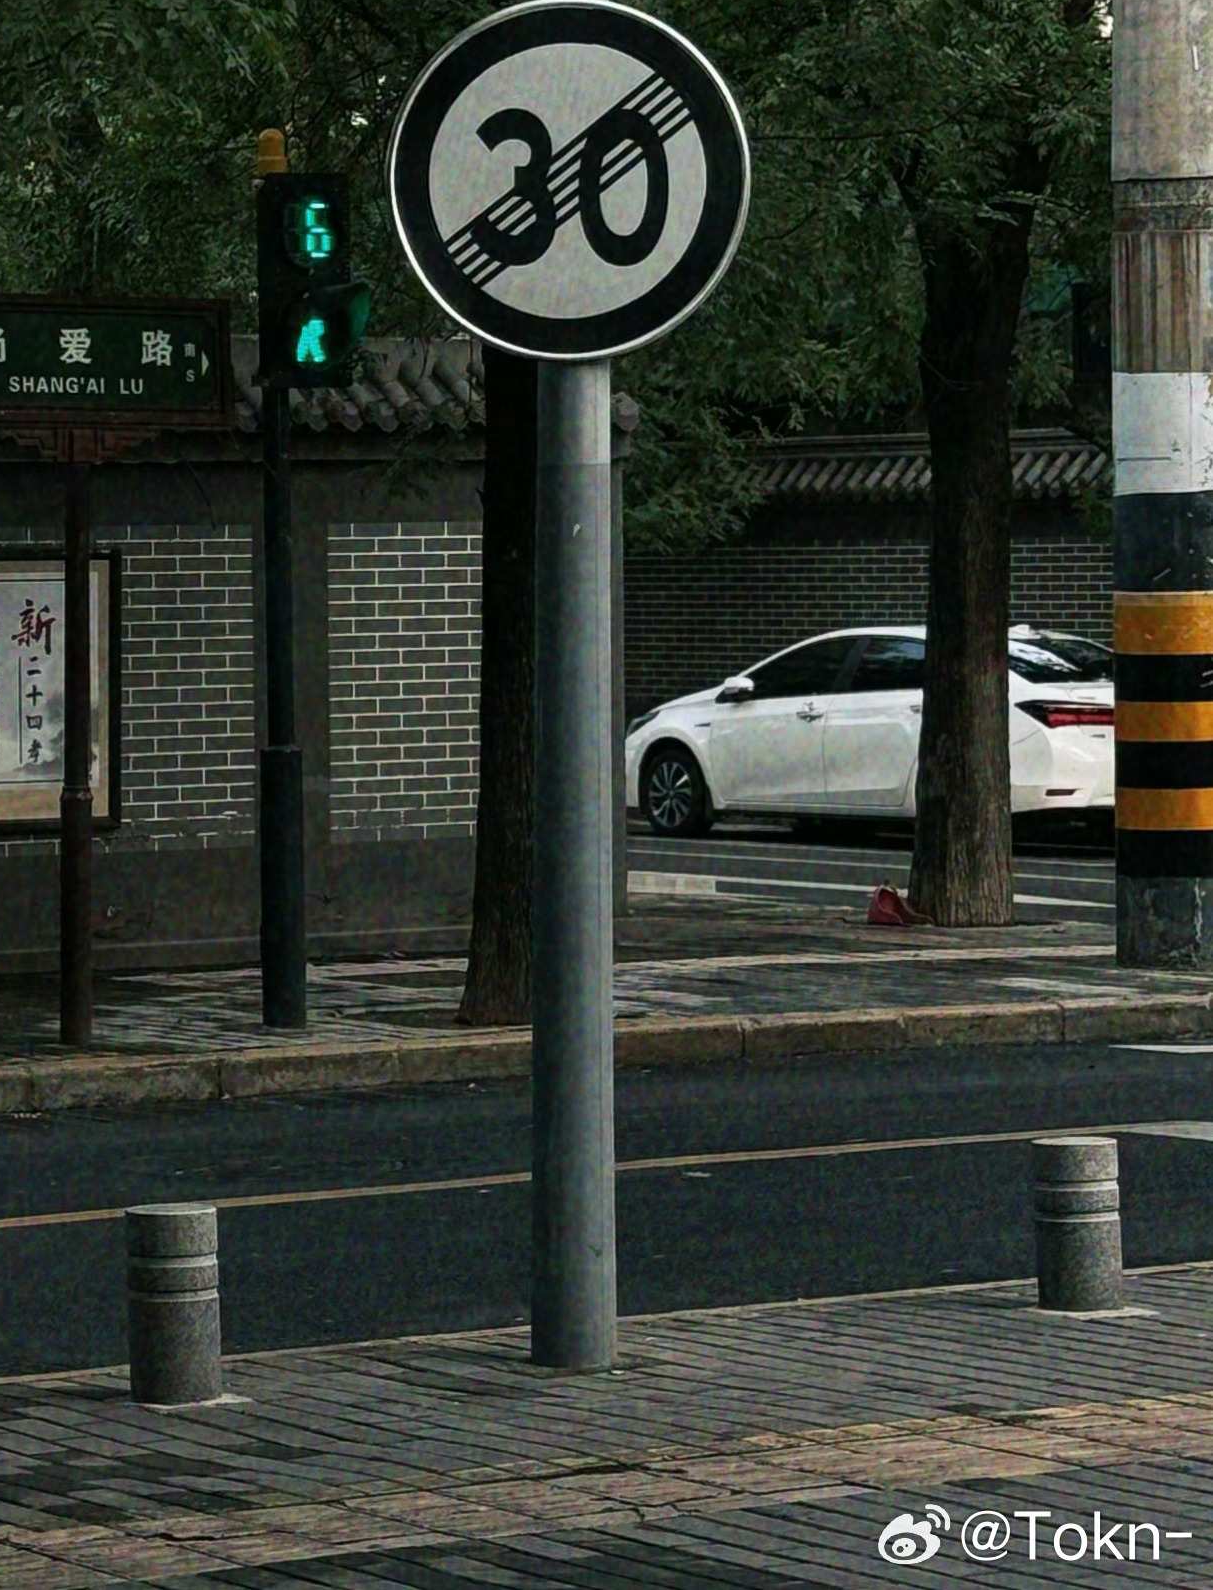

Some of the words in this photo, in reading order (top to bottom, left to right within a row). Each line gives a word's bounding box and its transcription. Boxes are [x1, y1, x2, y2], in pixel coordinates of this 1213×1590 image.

[476, 107, 669, 267] 30
[305, 203, 332, 258] 6
[184, 343, 196, 357] 南
[8, 376, 105, 395] SHANG'AI
[120, 378, 144, 395] LU
[186, 370, 196, 382] S
